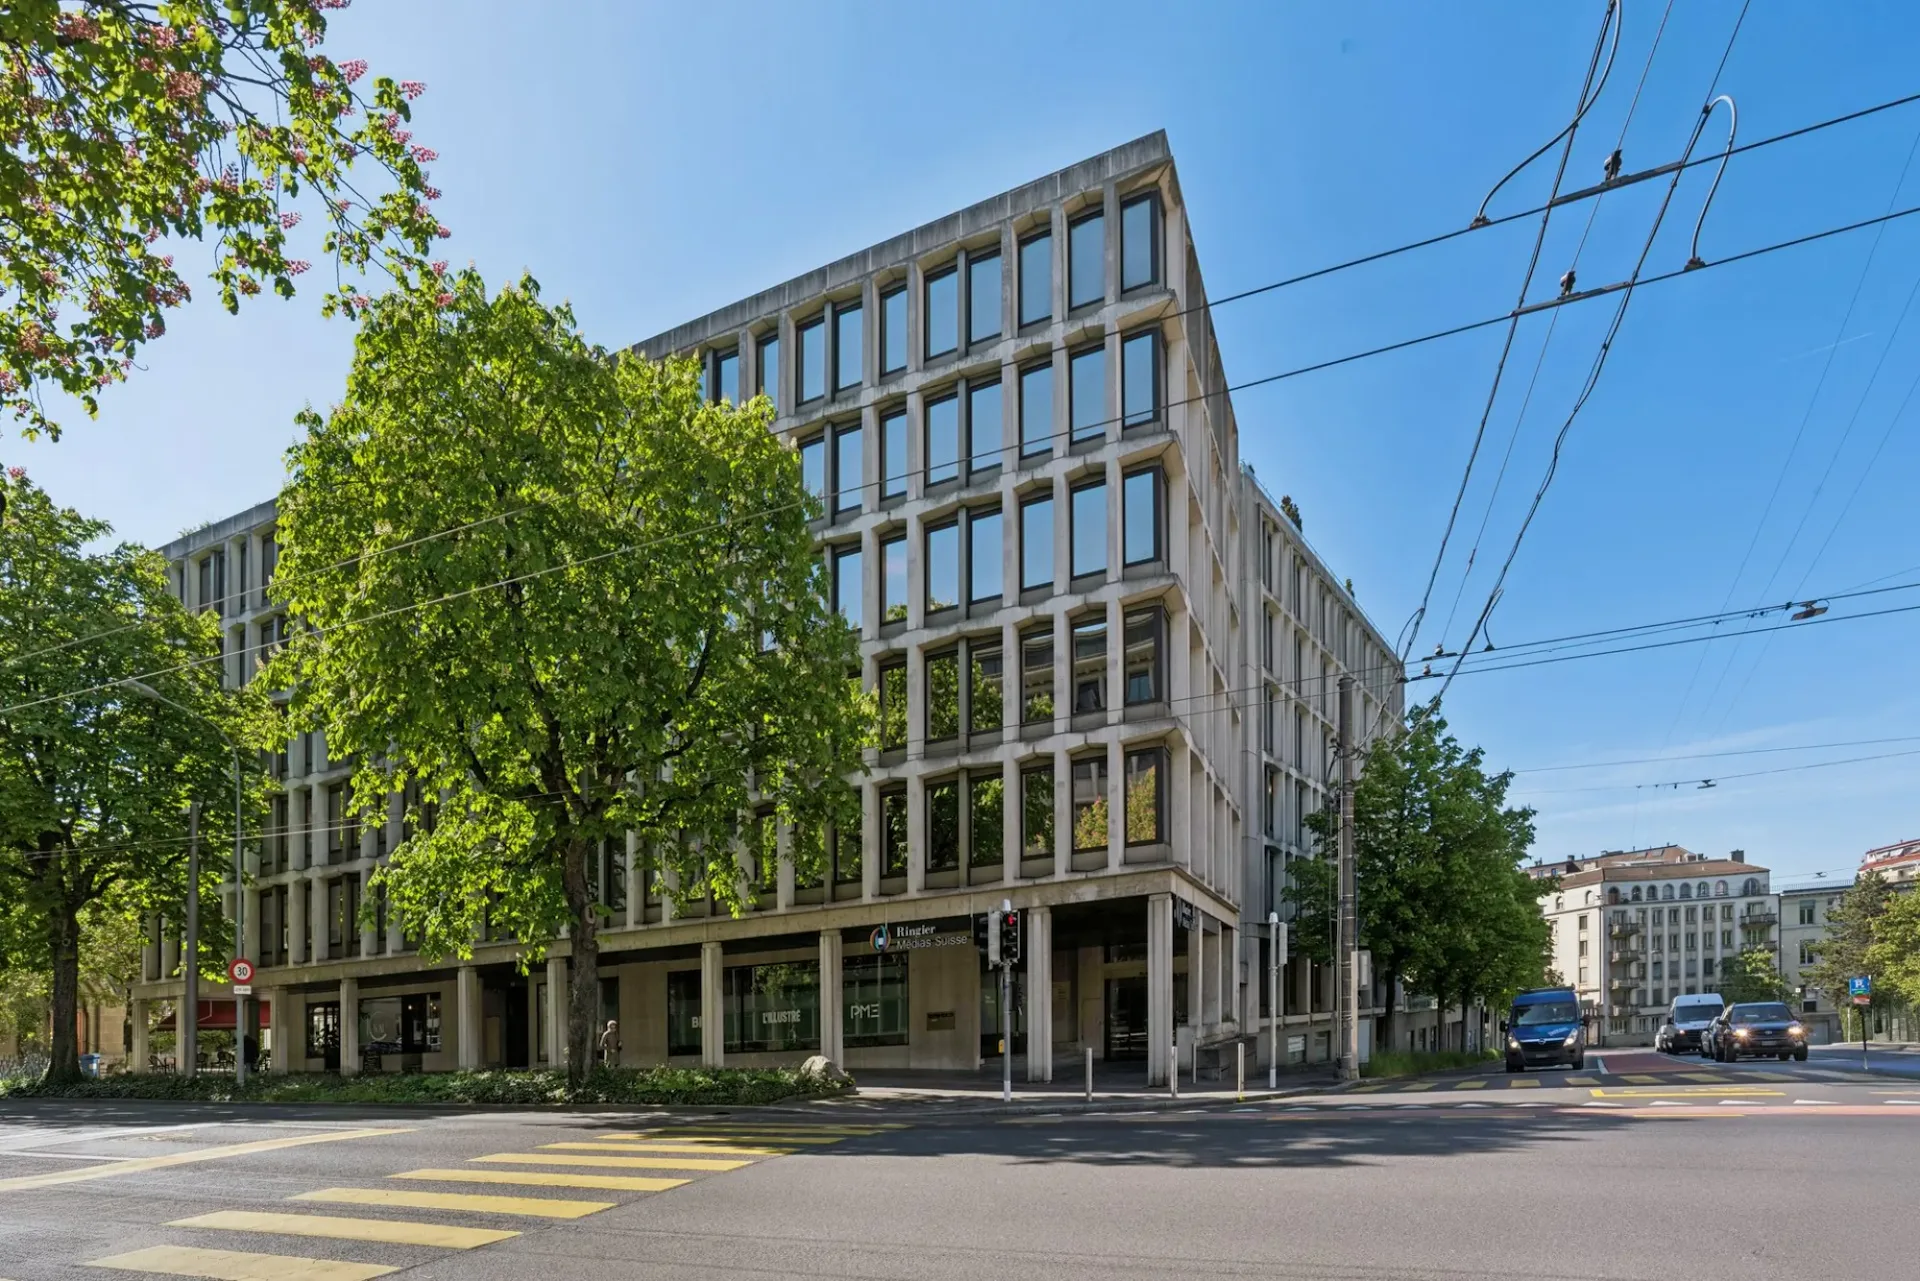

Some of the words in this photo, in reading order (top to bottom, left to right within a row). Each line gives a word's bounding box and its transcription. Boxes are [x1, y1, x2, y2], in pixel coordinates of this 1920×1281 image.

[896, 925, 936, 938] Ringier
[896, 937, 932, 950] Médias
[935, 935, 968, 947] Suisse
[237, 966, 248, 977] 30
[762, 1009, 801, 1024] L'ILLUSTRÉ
[850, 1003, 880, 1020] PME
